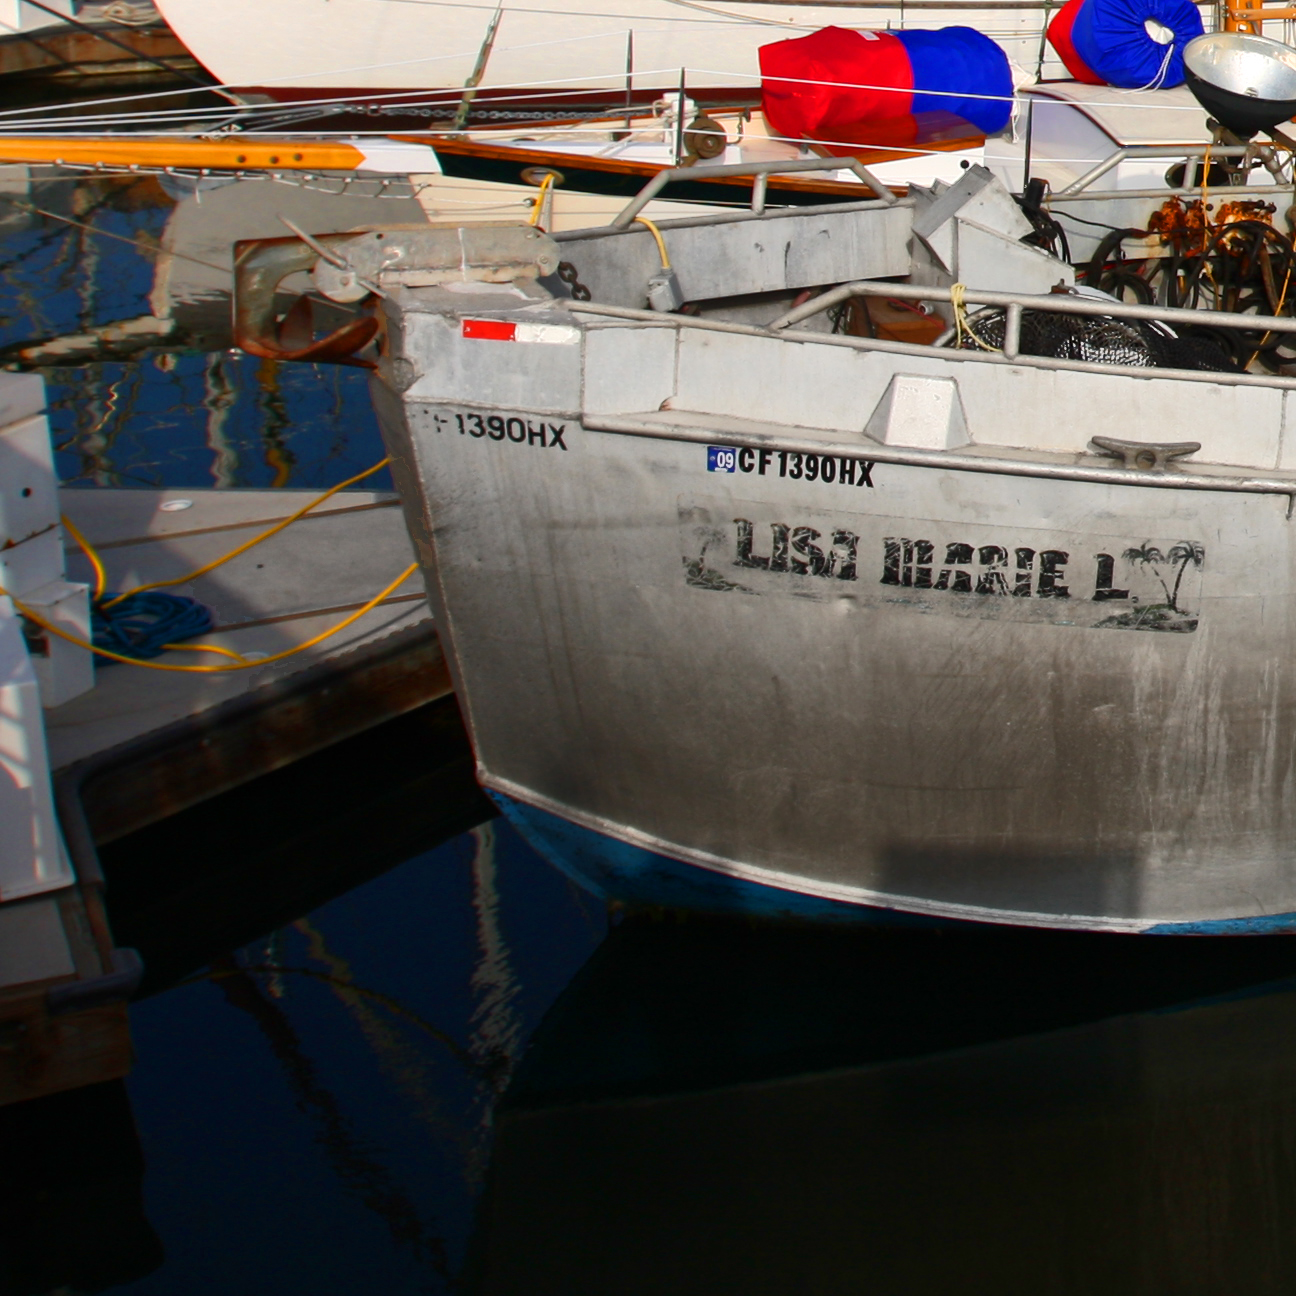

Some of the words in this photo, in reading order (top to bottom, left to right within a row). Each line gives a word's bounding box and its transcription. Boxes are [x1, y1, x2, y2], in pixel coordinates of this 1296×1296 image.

[717, 451, 734, 469] 09
[733, 518, 859, 581] LISA
[882, 535, 1071, 599] MARIE
